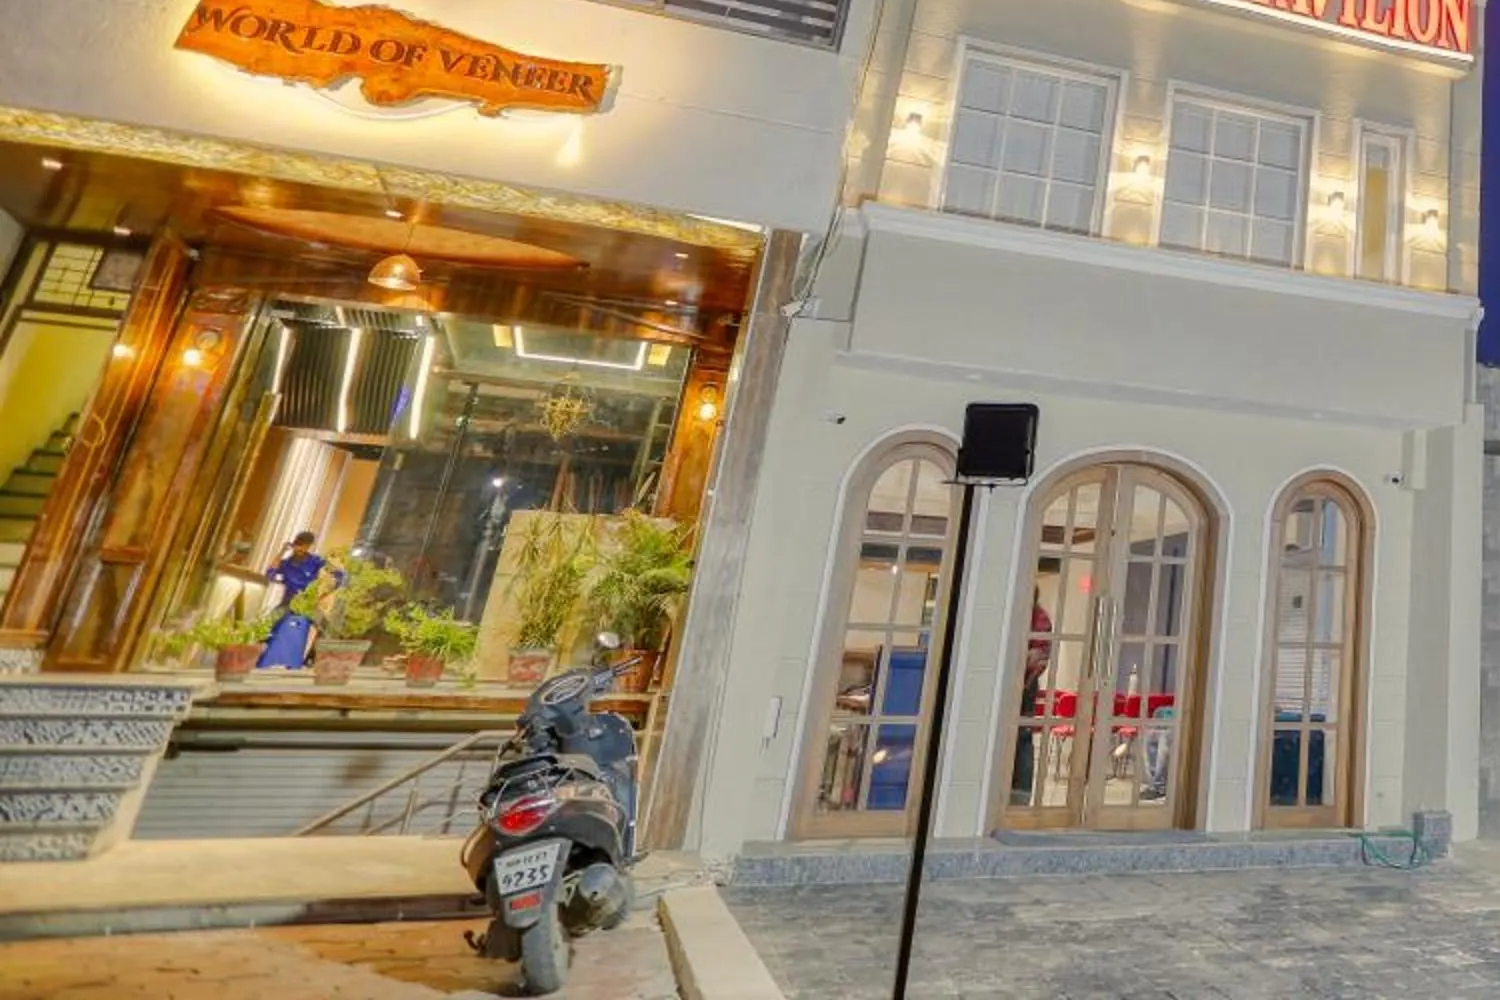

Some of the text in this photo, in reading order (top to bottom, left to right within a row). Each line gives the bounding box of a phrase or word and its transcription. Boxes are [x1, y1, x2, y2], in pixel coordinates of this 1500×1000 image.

[194, 5, 596, 101] WORLD OF VENEER
